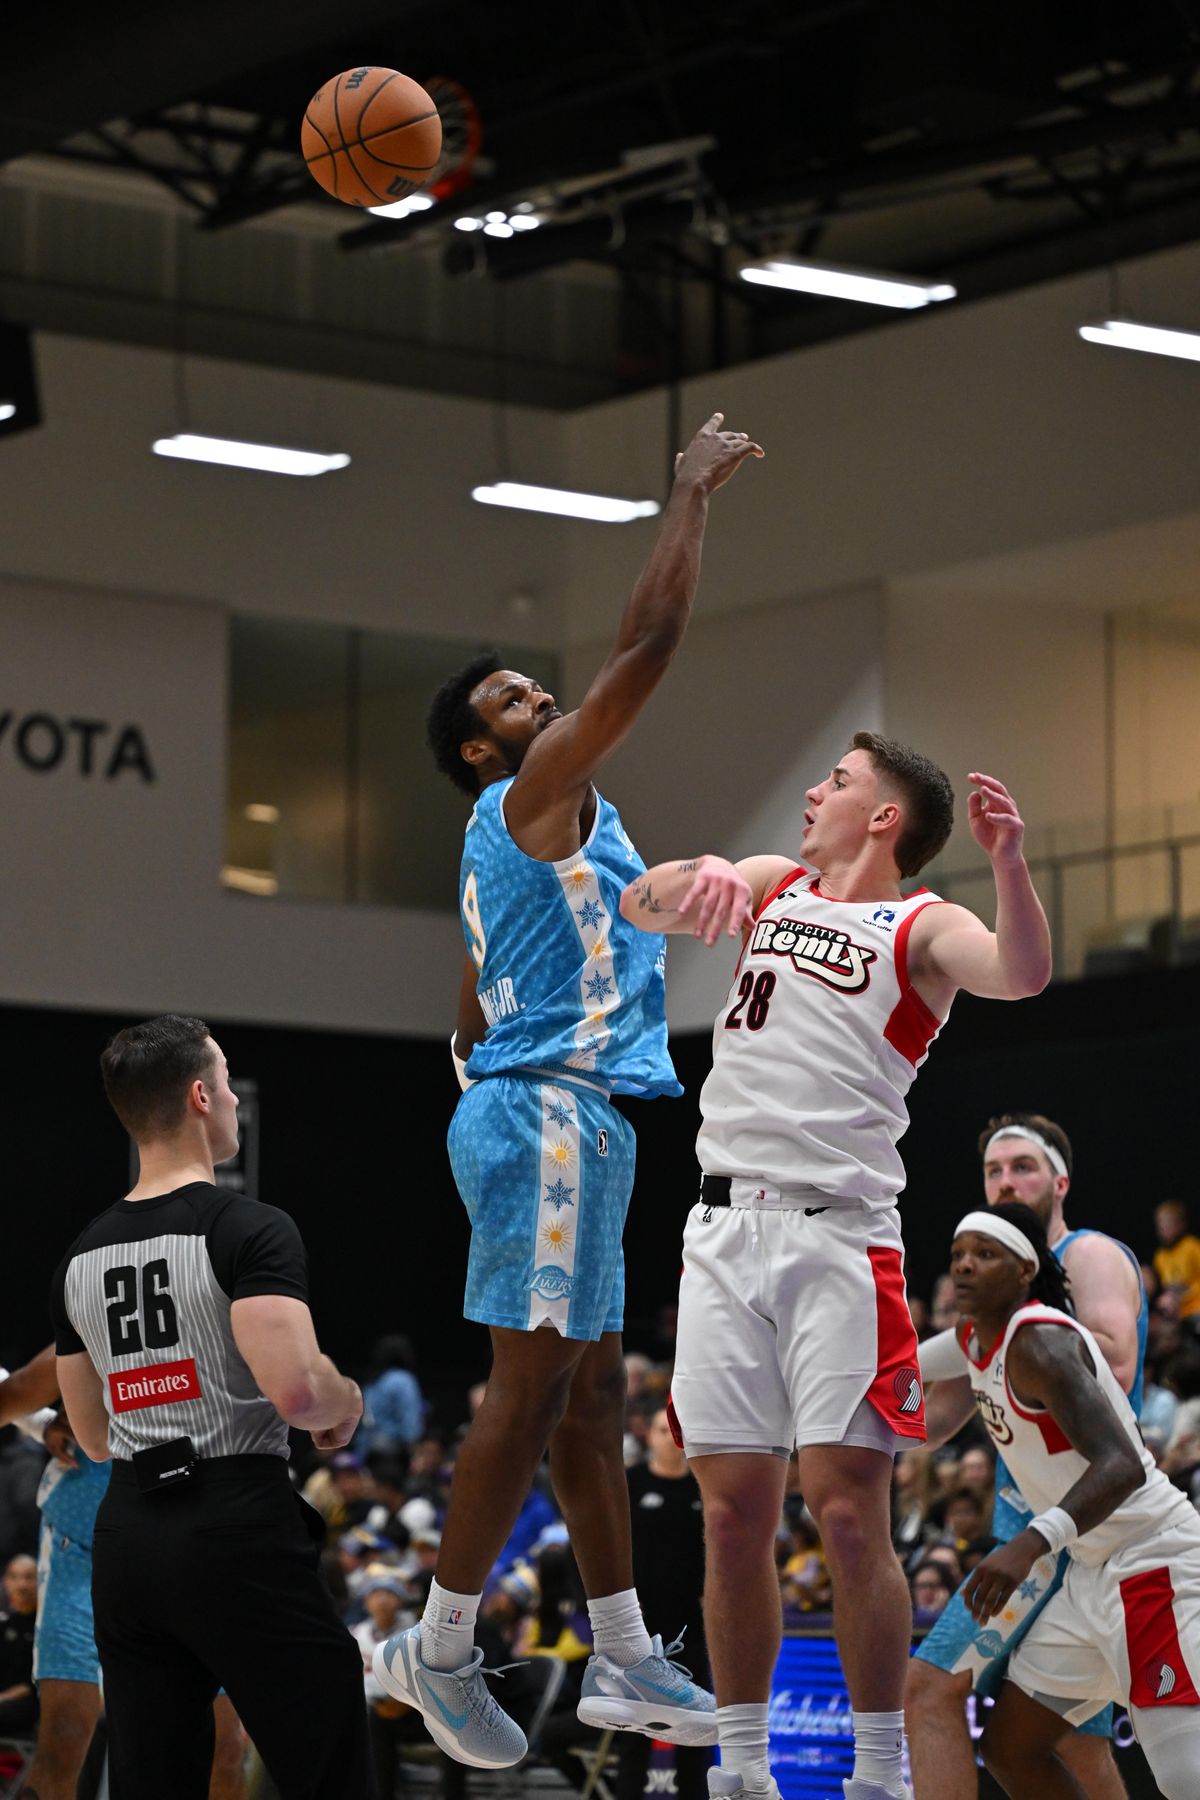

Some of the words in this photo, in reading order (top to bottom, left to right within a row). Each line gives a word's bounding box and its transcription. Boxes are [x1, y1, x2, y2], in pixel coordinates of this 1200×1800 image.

[752, 922, 873, 988] Remix
[496, 976, 527, 1017] JR.
[724, 970, 777, 1031] 28
[104, 1258, 179, 1357] 26
[117, 1373, 190, 1401] Emirates
